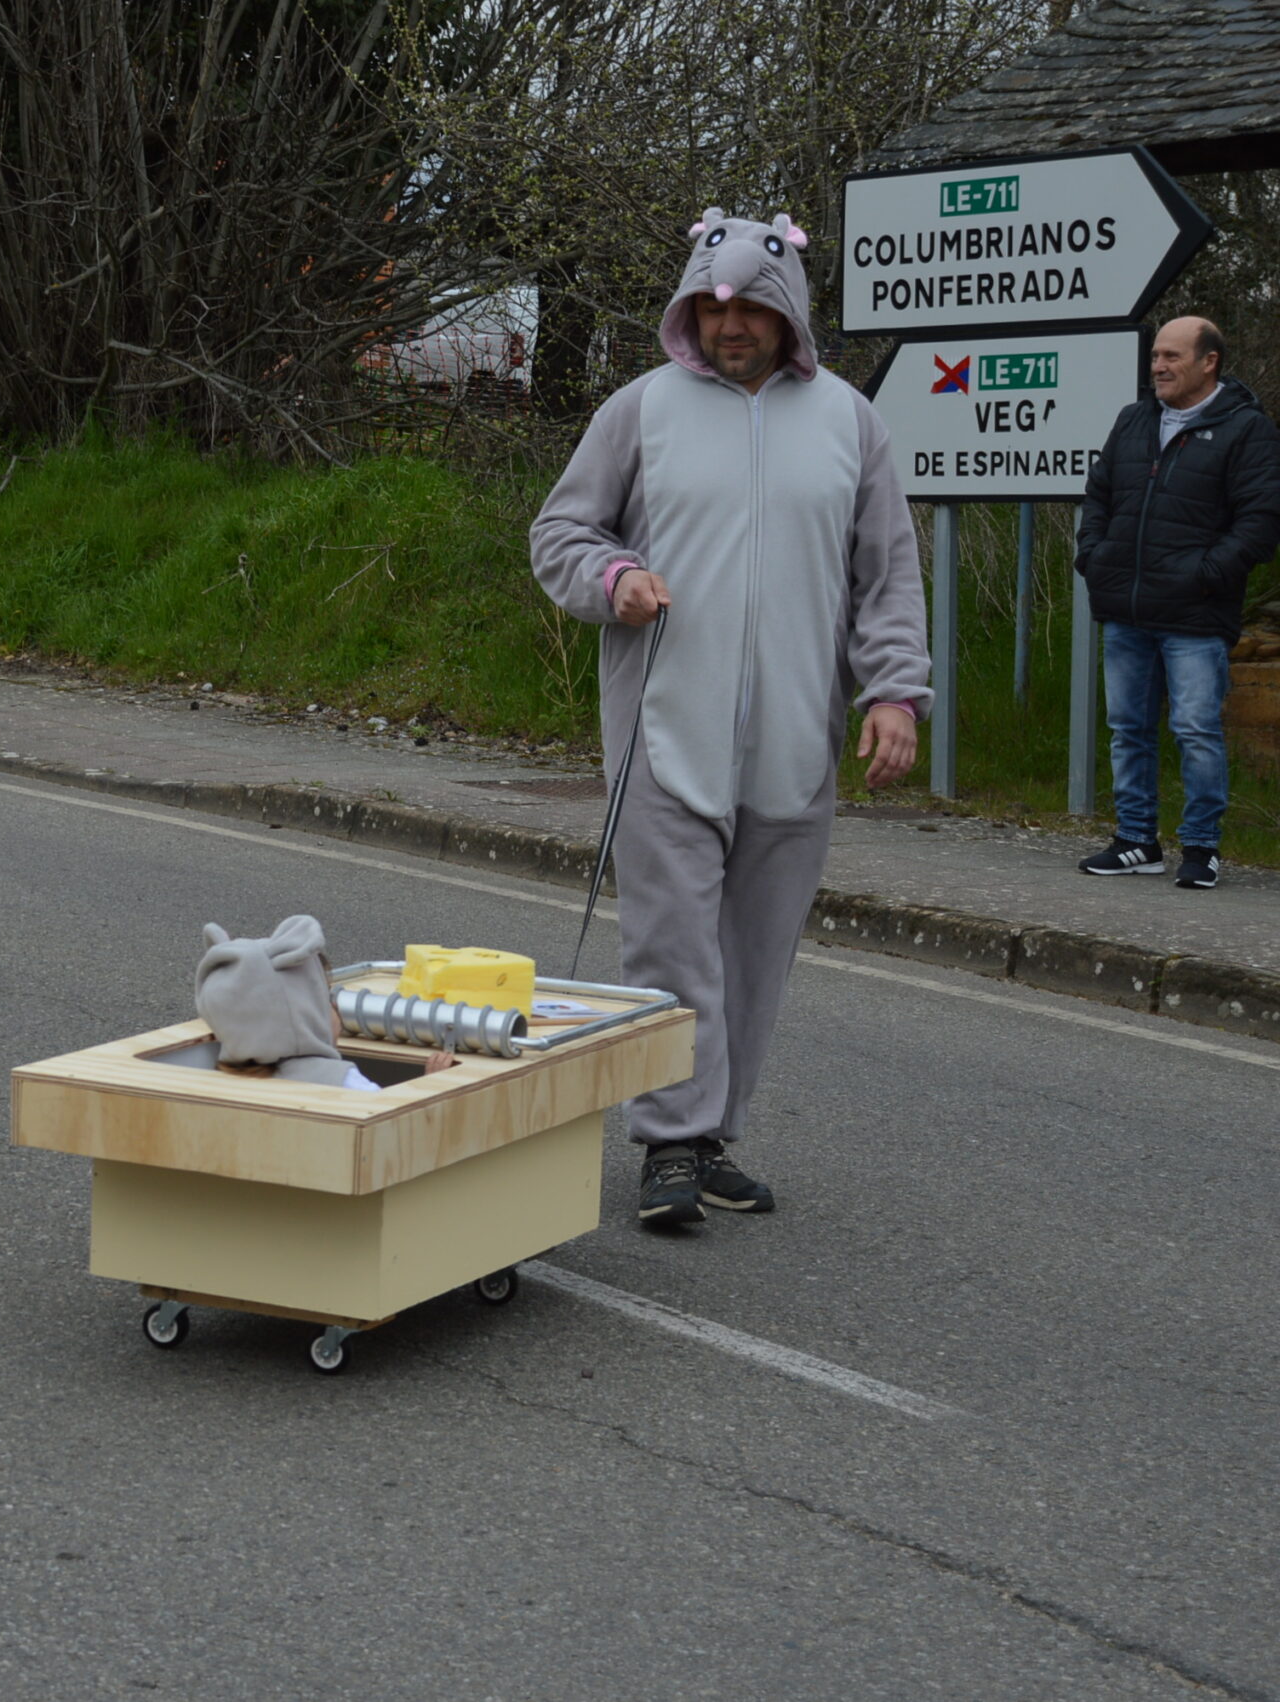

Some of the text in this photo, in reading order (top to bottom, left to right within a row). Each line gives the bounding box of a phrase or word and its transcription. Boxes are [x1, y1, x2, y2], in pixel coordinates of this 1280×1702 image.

[942, 180, 1018, 213] LE-711
[853, 217, 1117, 268] COLUMBRIANOS
[872, 267, 1090, 312] PONFERRADA
[980, 356, 1057, 386] LE-711
[914, 451, 945, 477] DE
